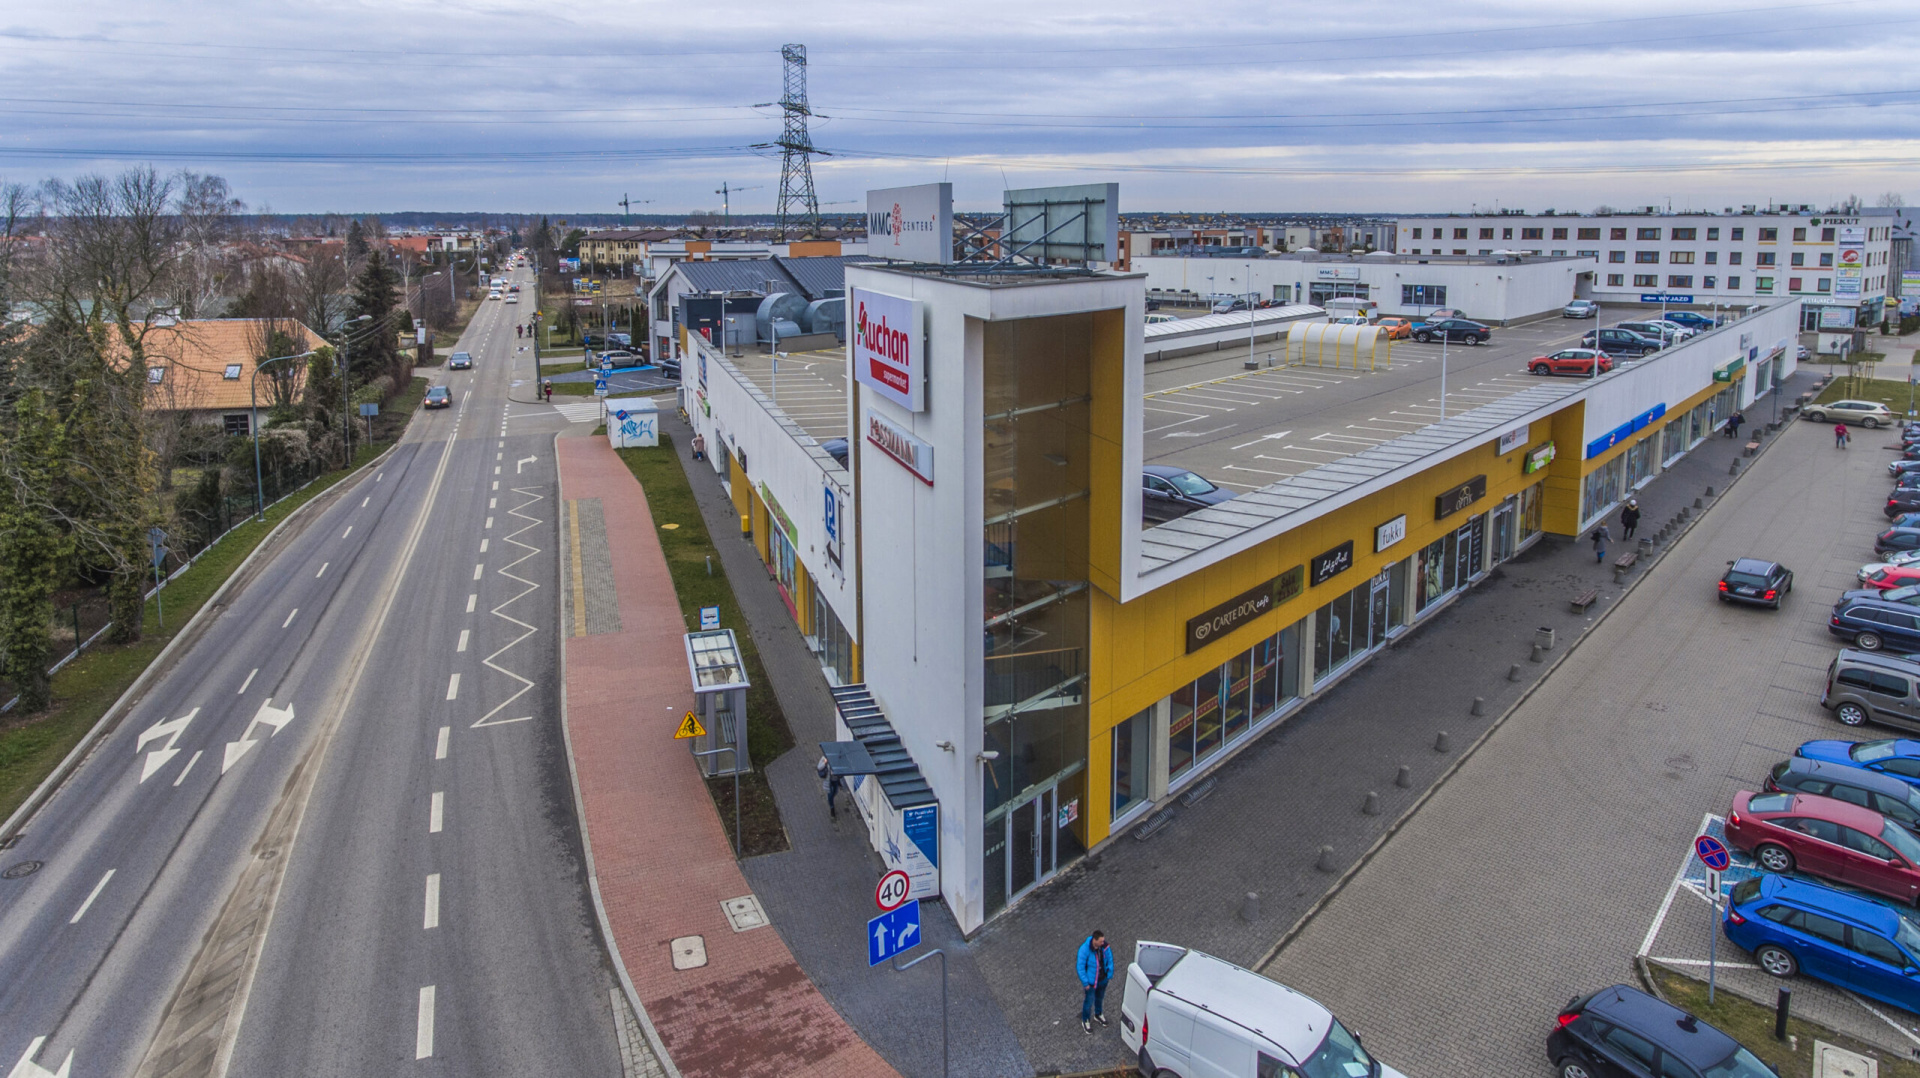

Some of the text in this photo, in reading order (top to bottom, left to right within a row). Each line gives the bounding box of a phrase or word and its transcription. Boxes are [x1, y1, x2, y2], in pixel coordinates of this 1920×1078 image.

[870, 212, 933, 236] MMG CENTERS
[1823, 217, 1860, 225] PIEKUT
[1658, 295, 1690, 303] WYJAZD
[857, 300, 909, 367] Auchan
[883, 369, 908, 390] supermarket
[869, 415, 920, 470] ROSSMANN
[1382, 521, 1402, 545] fukki
[1212, 608, 1238, 632] CARTE
[881, 878, 905, 902] 40
